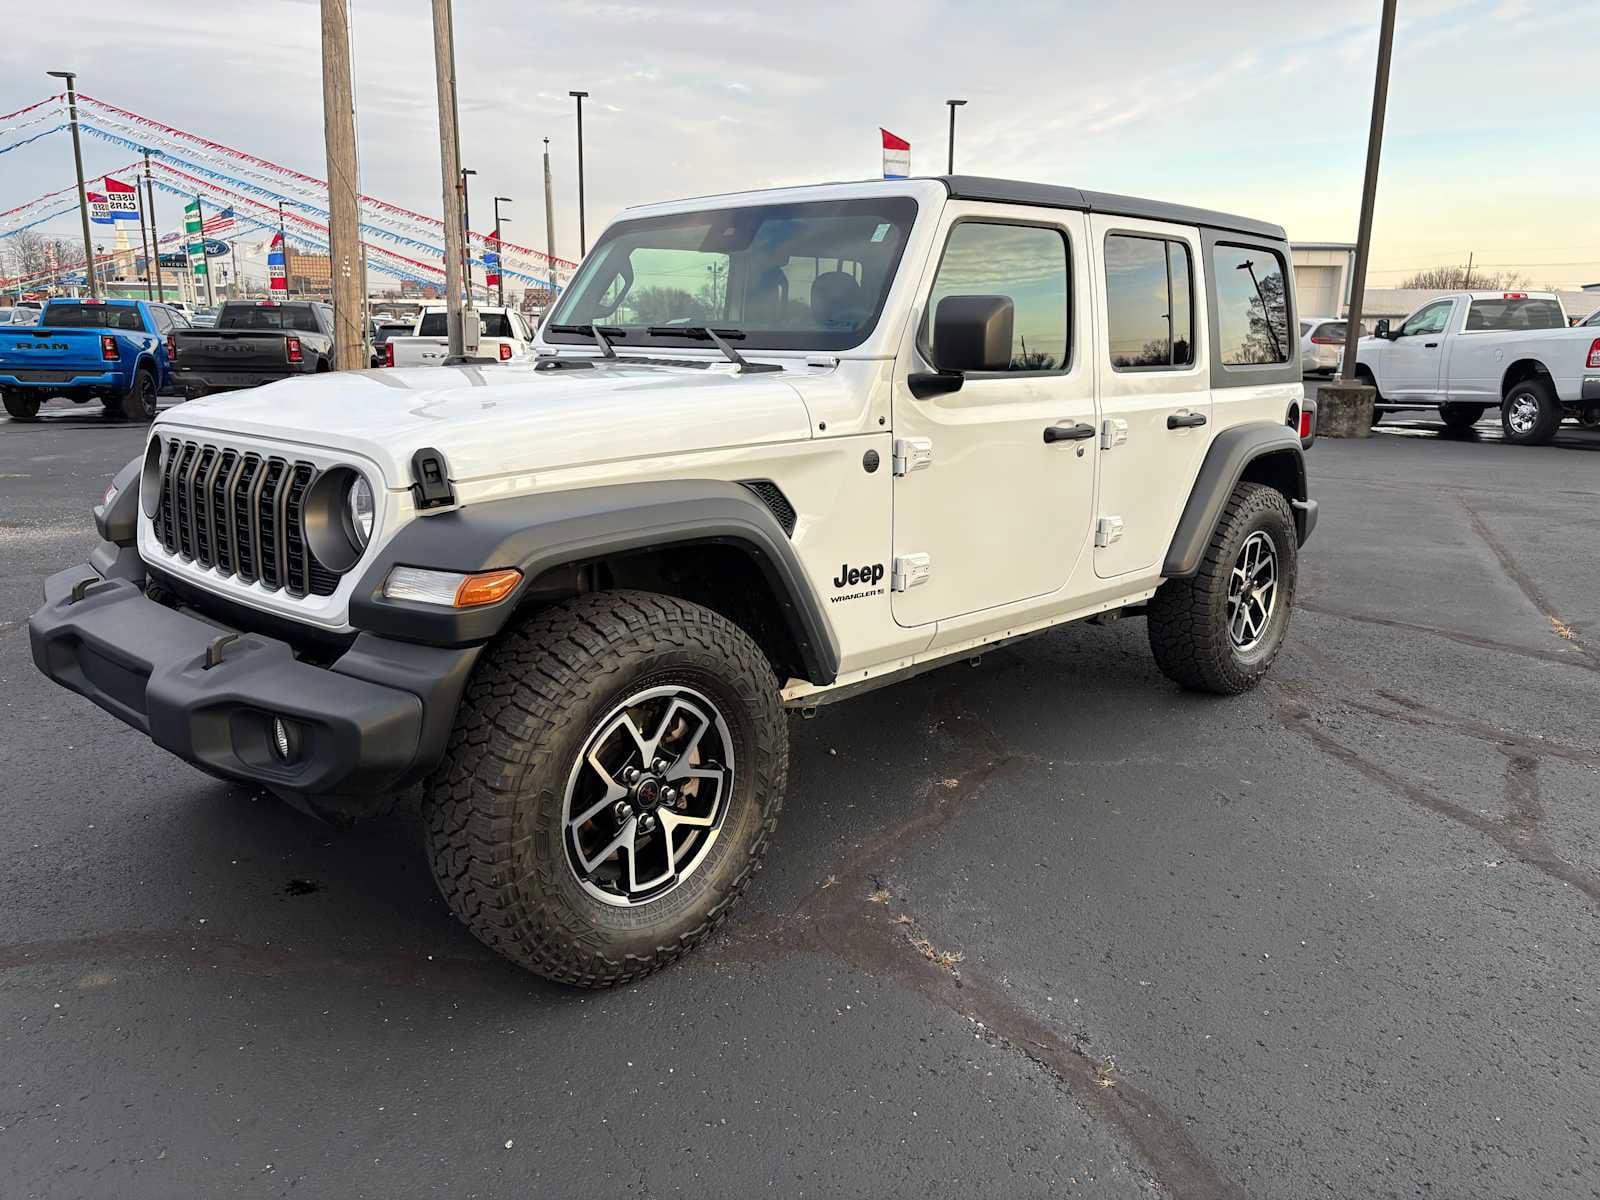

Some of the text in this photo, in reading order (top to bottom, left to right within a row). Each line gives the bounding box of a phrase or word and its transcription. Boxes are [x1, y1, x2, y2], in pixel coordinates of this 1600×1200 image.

[16, 342, 70, 351] RAM
[204, 344, 256, 352] RAM
[833, 563, 884, 588] Jeep
[830, 590, 876, 603] WRANGLER
